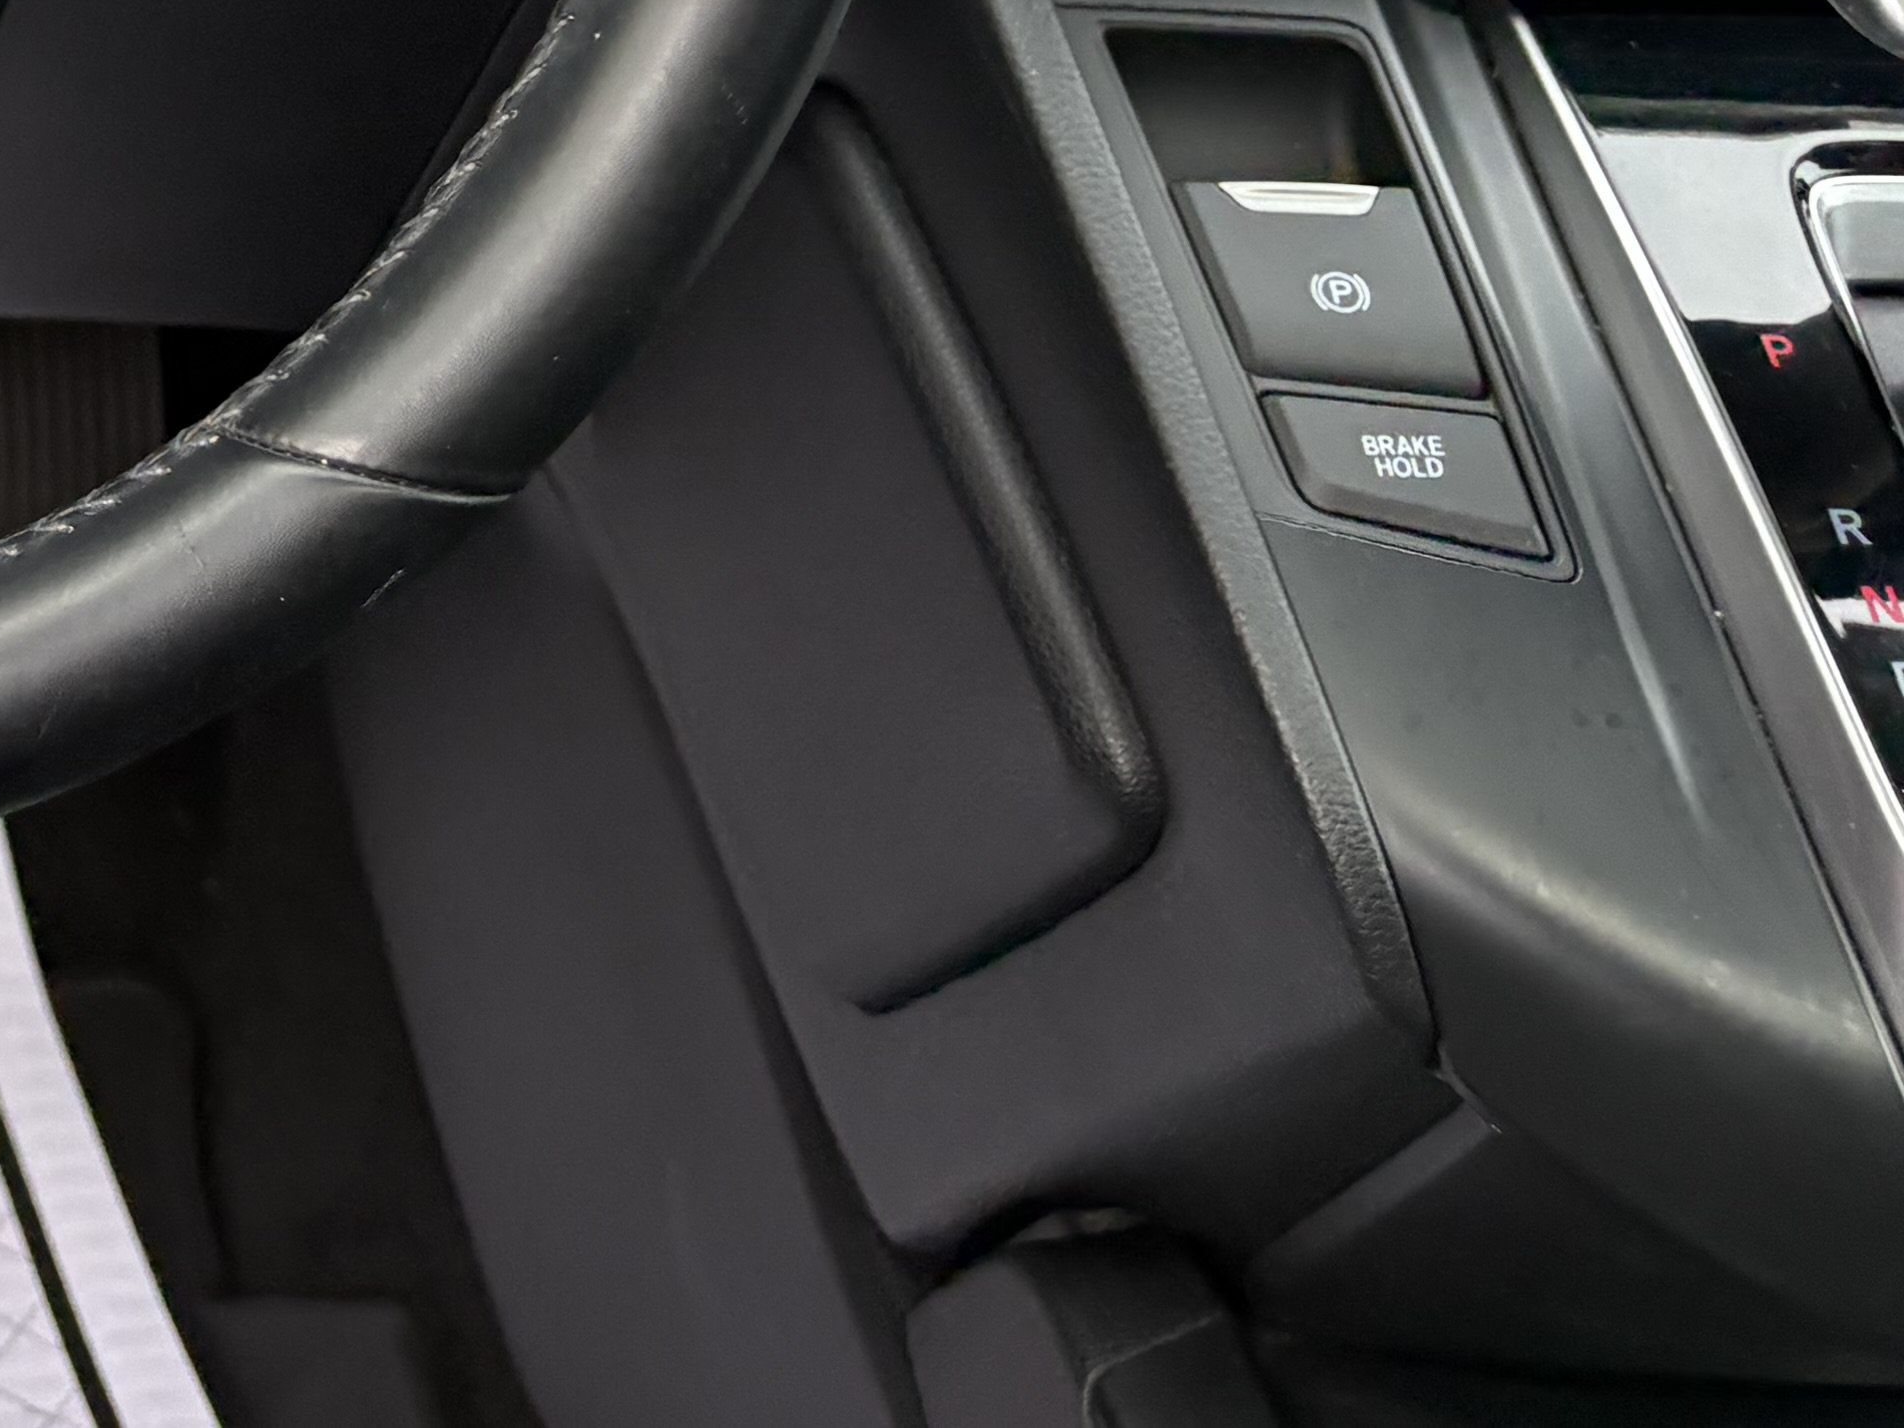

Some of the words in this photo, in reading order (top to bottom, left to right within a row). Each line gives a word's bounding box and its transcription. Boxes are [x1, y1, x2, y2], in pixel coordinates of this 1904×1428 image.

[1759, 334, 1794, 369] P
[1361, 434, 1446, 458] BRAKE
[1374, 456, 1444, 479] HOLD
[1827, 507, 1874, 545] R
